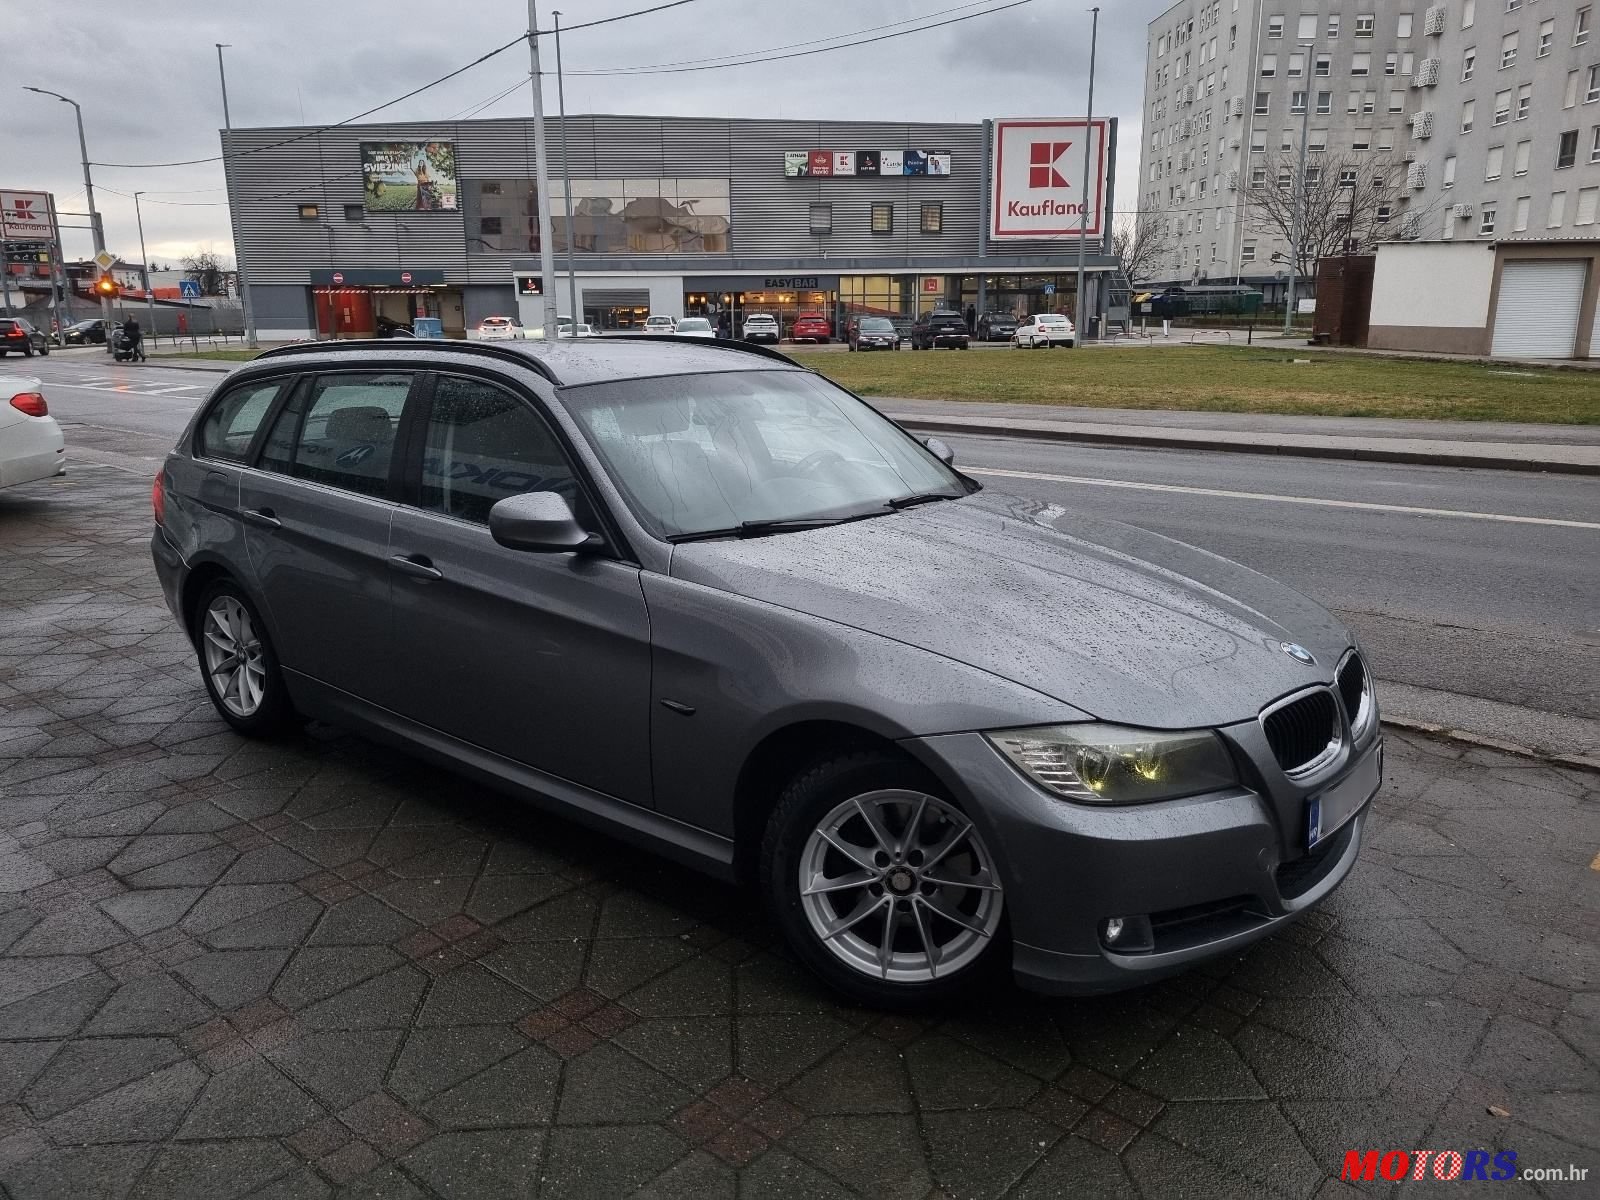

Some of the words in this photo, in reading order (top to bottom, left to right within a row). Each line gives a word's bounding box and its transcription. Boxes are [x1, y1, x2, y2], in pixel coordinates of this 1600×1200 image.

[1008, 198, 1089, 217] Kaufland
[764, 279, 793, 288] EASY
[793, 278, 818, 288] BAR
